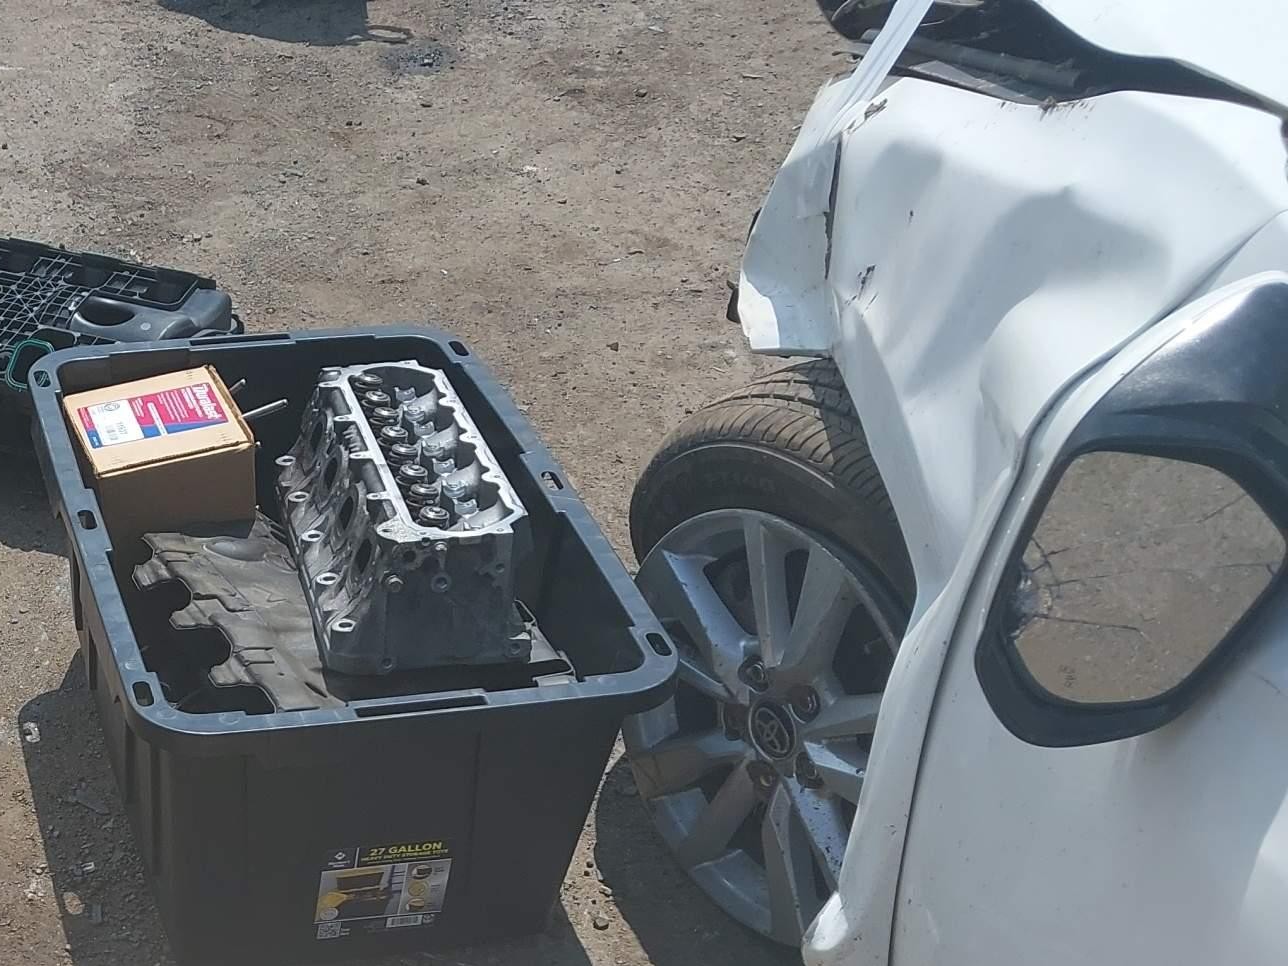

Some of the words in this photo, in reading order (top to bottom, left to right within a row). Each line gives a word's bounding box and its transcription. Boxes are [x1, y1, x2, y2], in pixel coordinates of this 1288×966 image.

[192, 384, 223, 420] Duralast
[369, 847, 386, 857] 27
[388, 842, 443, 855] GALLON
